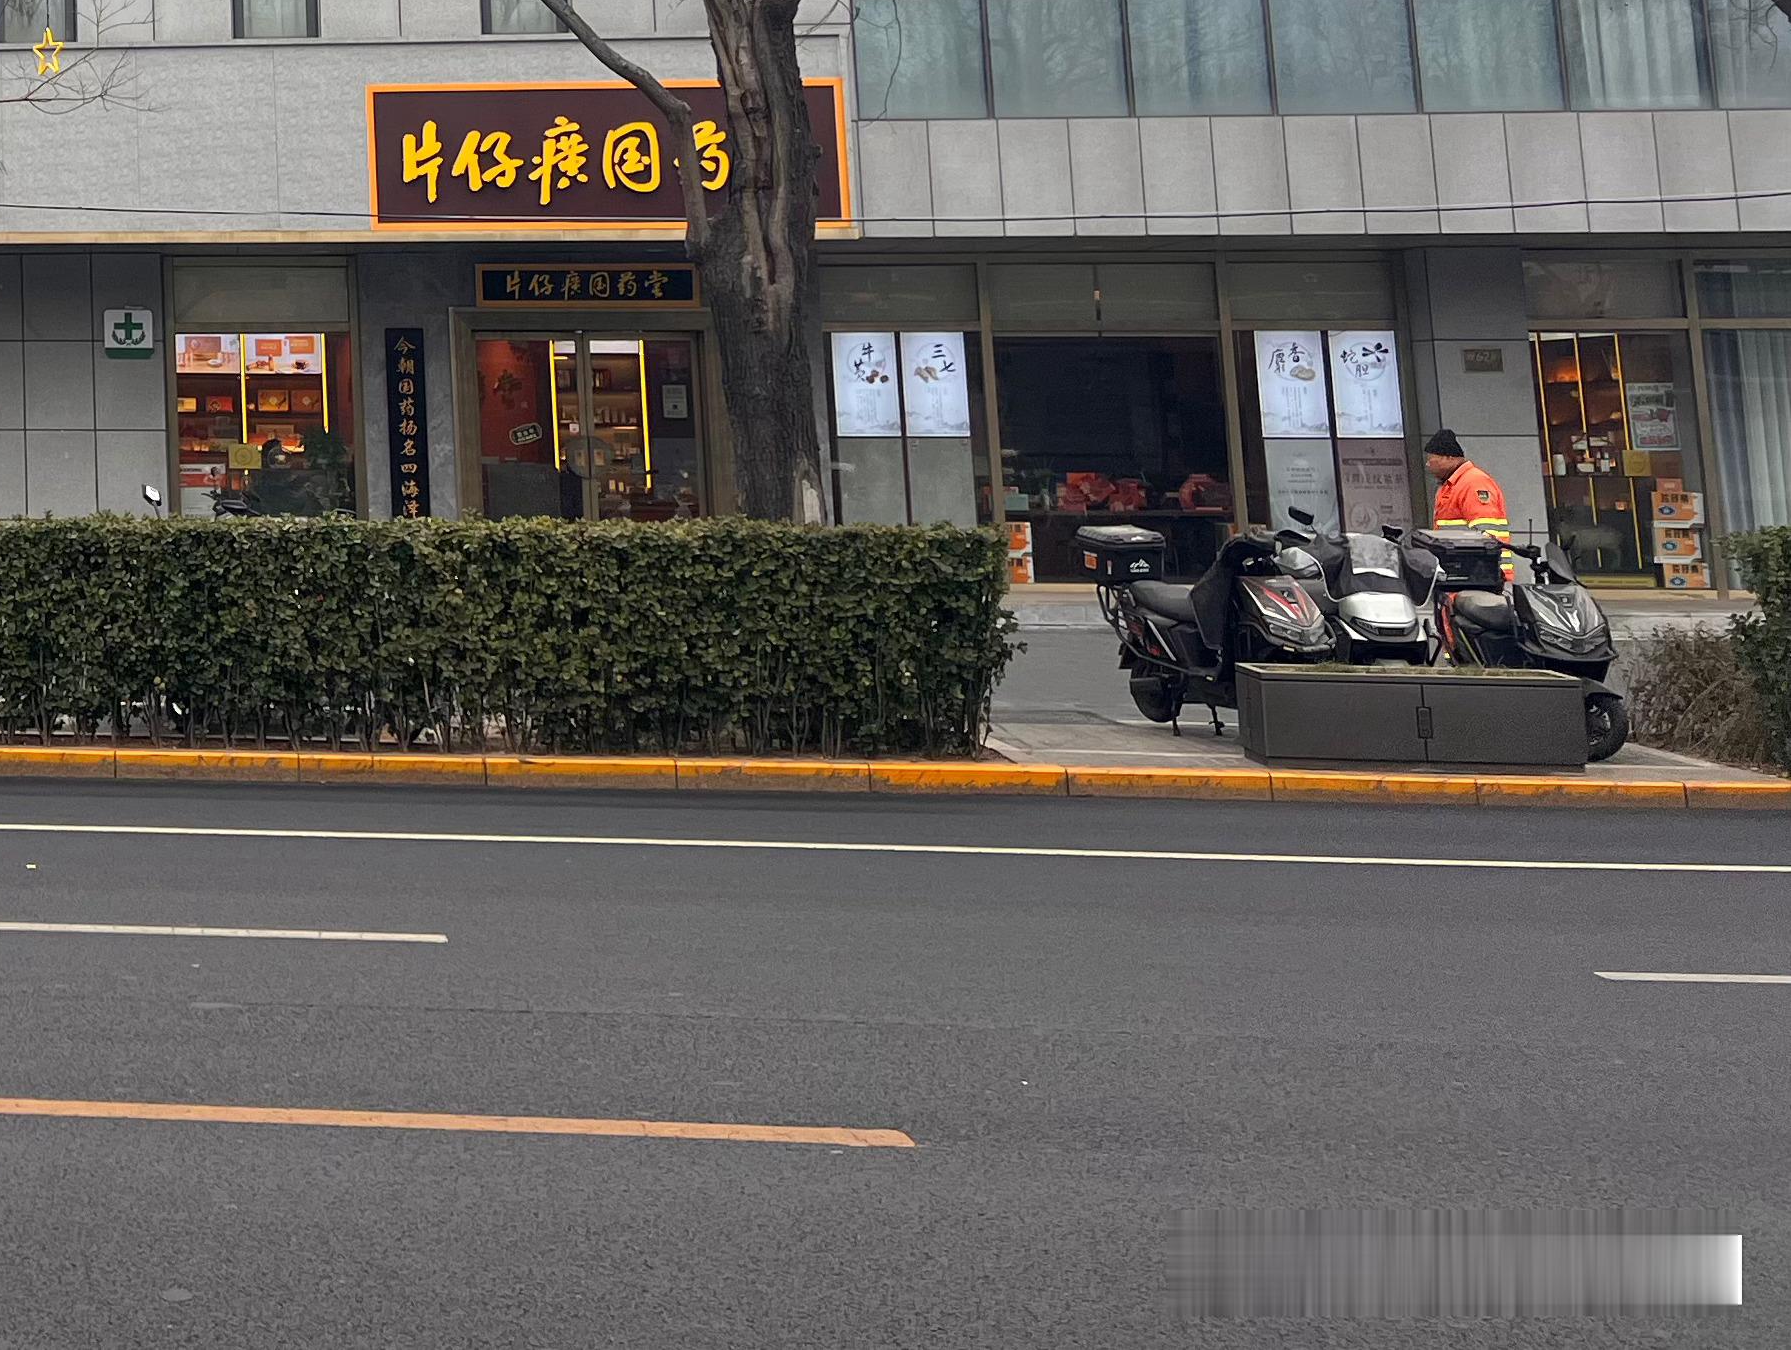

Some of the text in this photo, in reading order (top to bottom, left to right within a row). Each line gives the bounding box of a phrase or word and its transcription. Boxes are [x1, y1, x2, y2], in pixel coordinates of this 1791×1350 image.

[506, 269, 669, 300] 片仔癀国药堂
